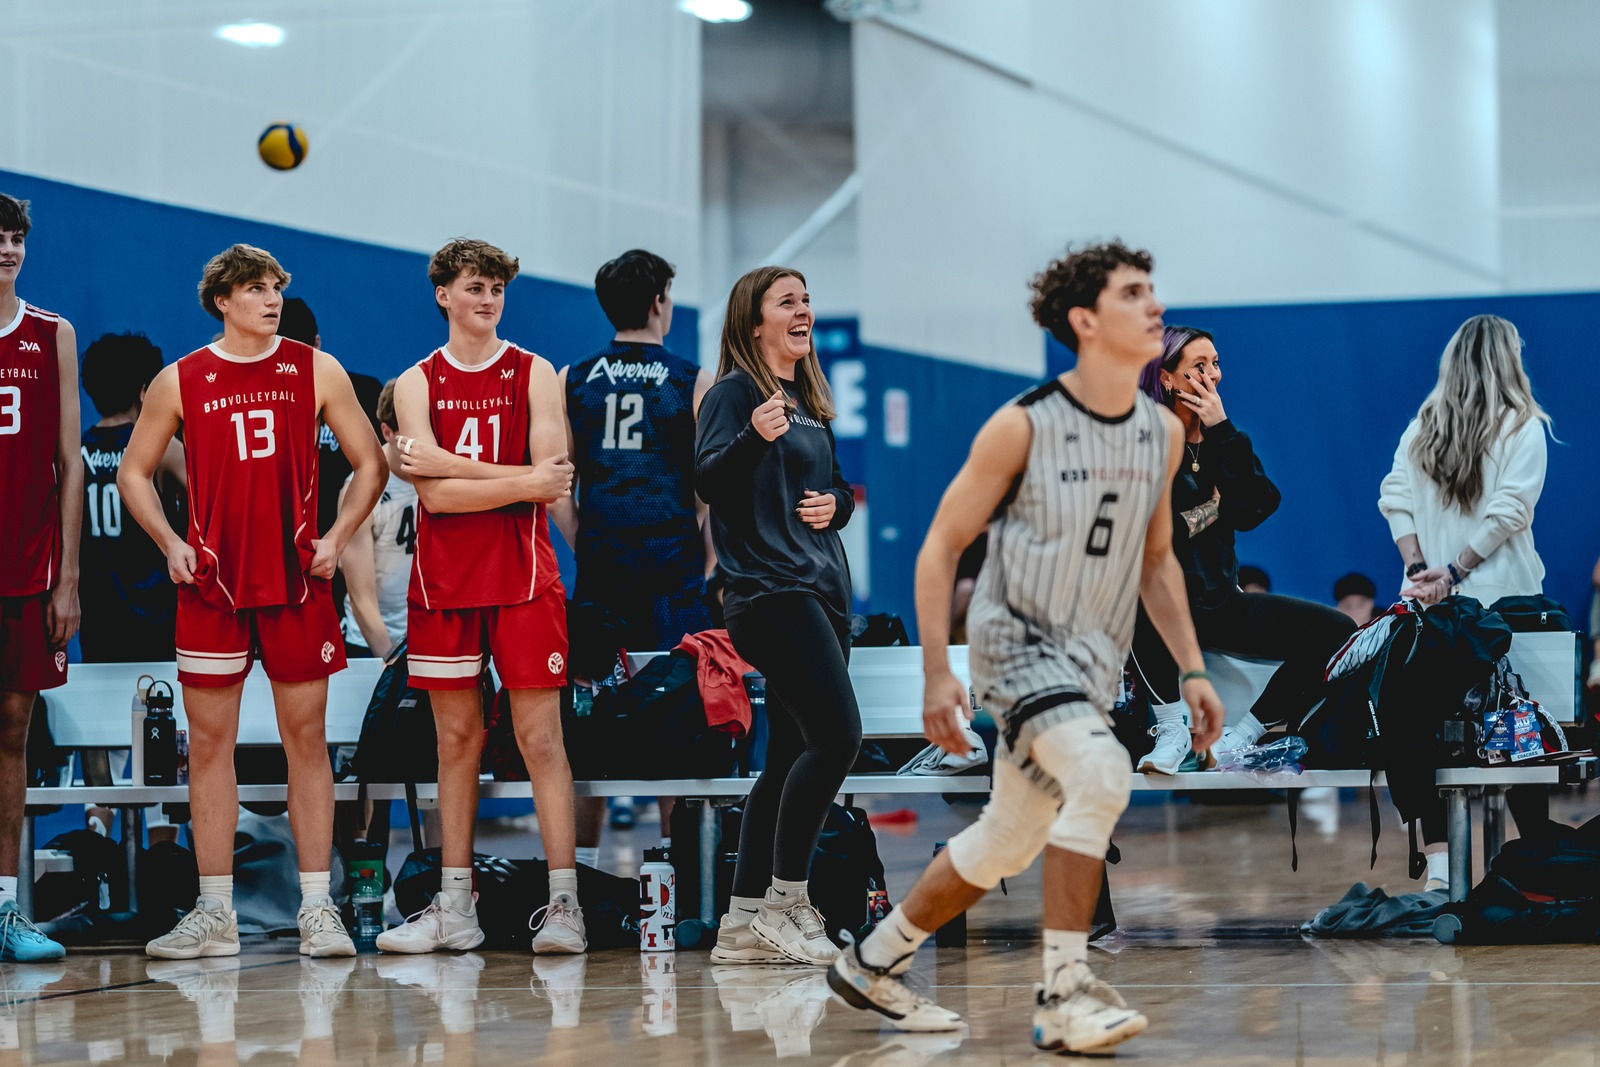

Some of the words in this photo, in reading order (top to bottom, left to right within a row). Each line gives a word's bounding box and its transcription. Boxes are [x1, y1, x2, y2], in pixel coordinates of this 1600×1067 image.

[586, 356, 669, 386] Adversity
[230, 409, 276, 462] 13
[455, 413, 500, 464] 41
[602, 392, 644, 450] 12
[87, 482, 122, 537] 10
[396, 505, 417, 555] 4
[1085, 492, 1119, 557] 6
